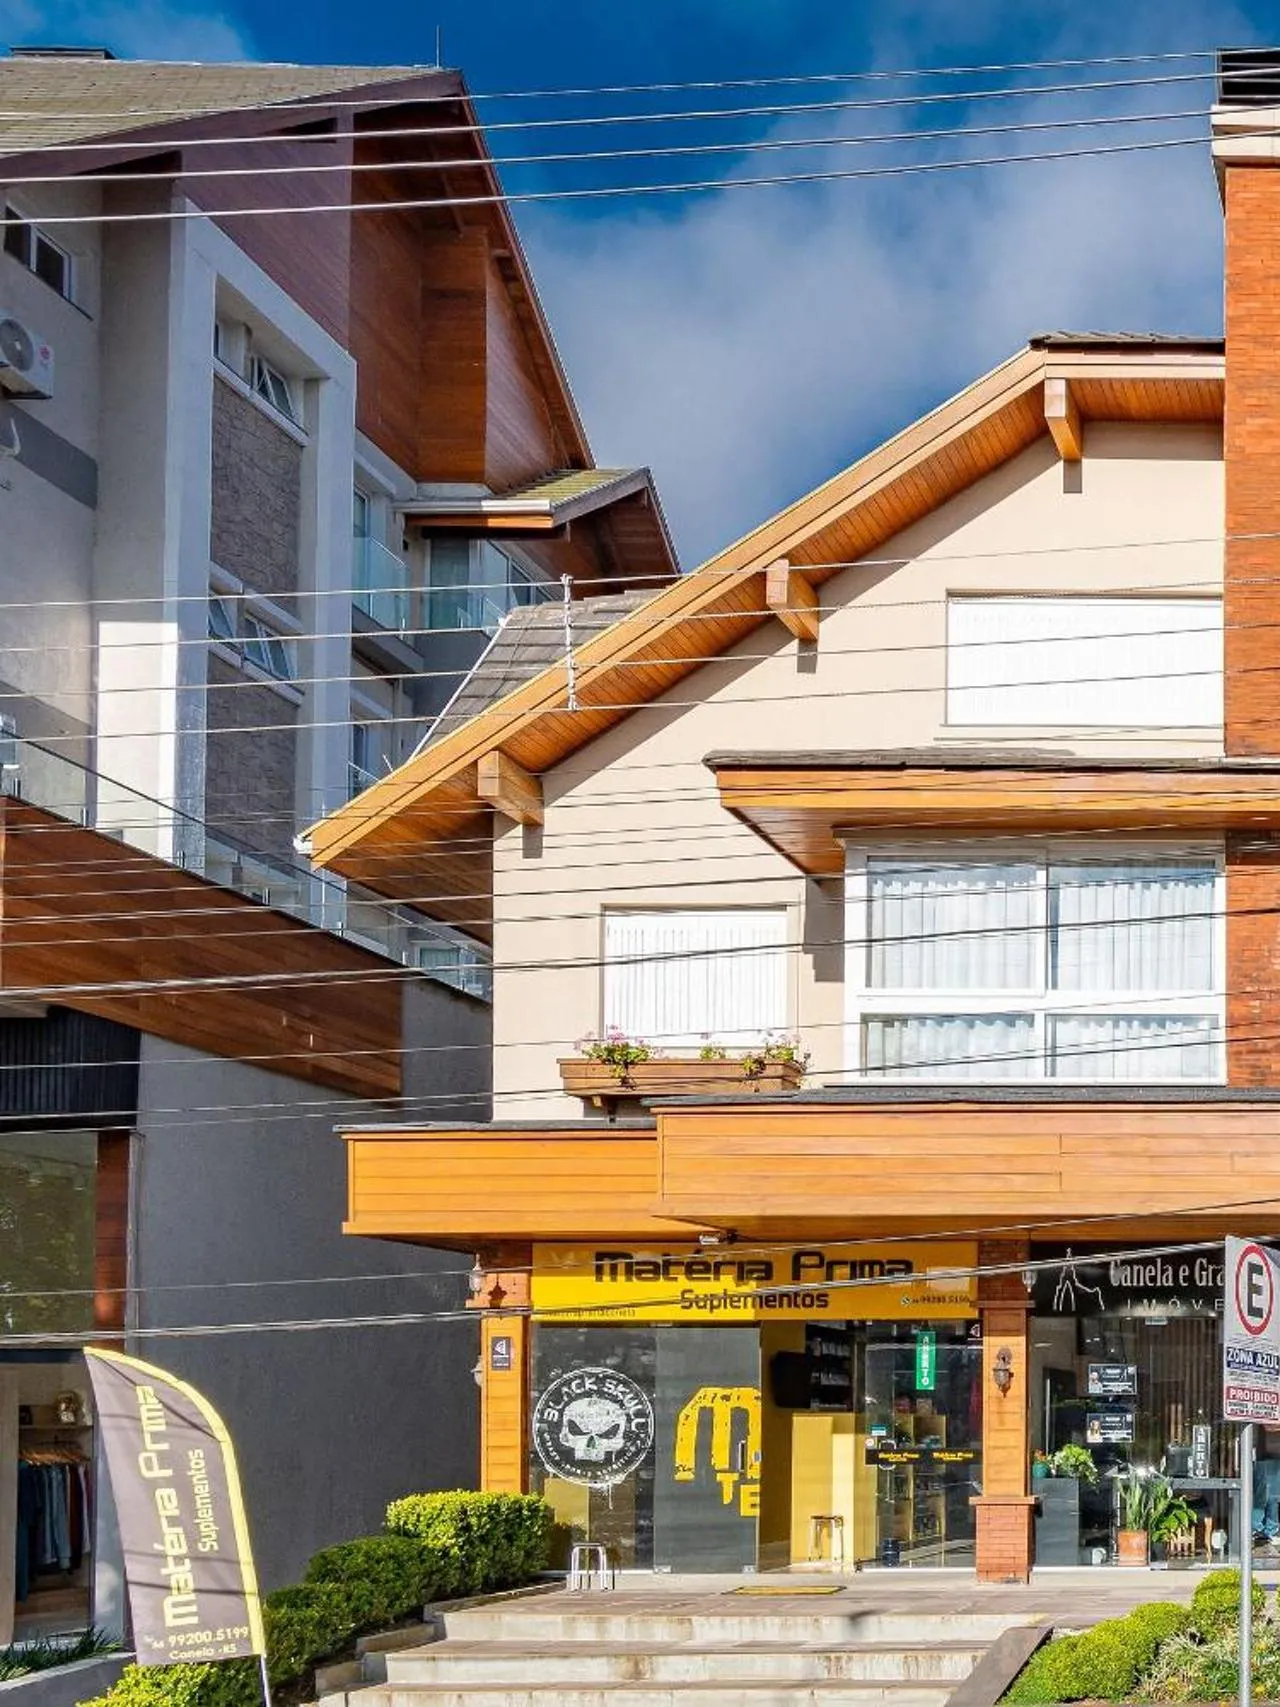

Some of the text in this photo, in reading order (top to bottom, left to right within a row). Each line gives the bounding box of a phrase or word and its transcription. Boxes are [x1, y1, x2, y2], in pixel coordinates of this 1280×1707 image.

[792, 1250, 913, 1286] Prima
[1109, 1257, 1174, 1287] Canela
[1179, 1264, 1189, 1287] e
[680, 1288, 829, 1313] Suplementos
[1247, 1261, 1264, 1319] E
[1227, 1348, 1254, 1365] ZONA
[1255, 1353, 1279, 1369] AZUL
[1229, 1388, 1278, 1404] PROIBIDO
[136, 1385, 173, 1479] Prima
[187, 1449, 219, 1552] Suplementos
